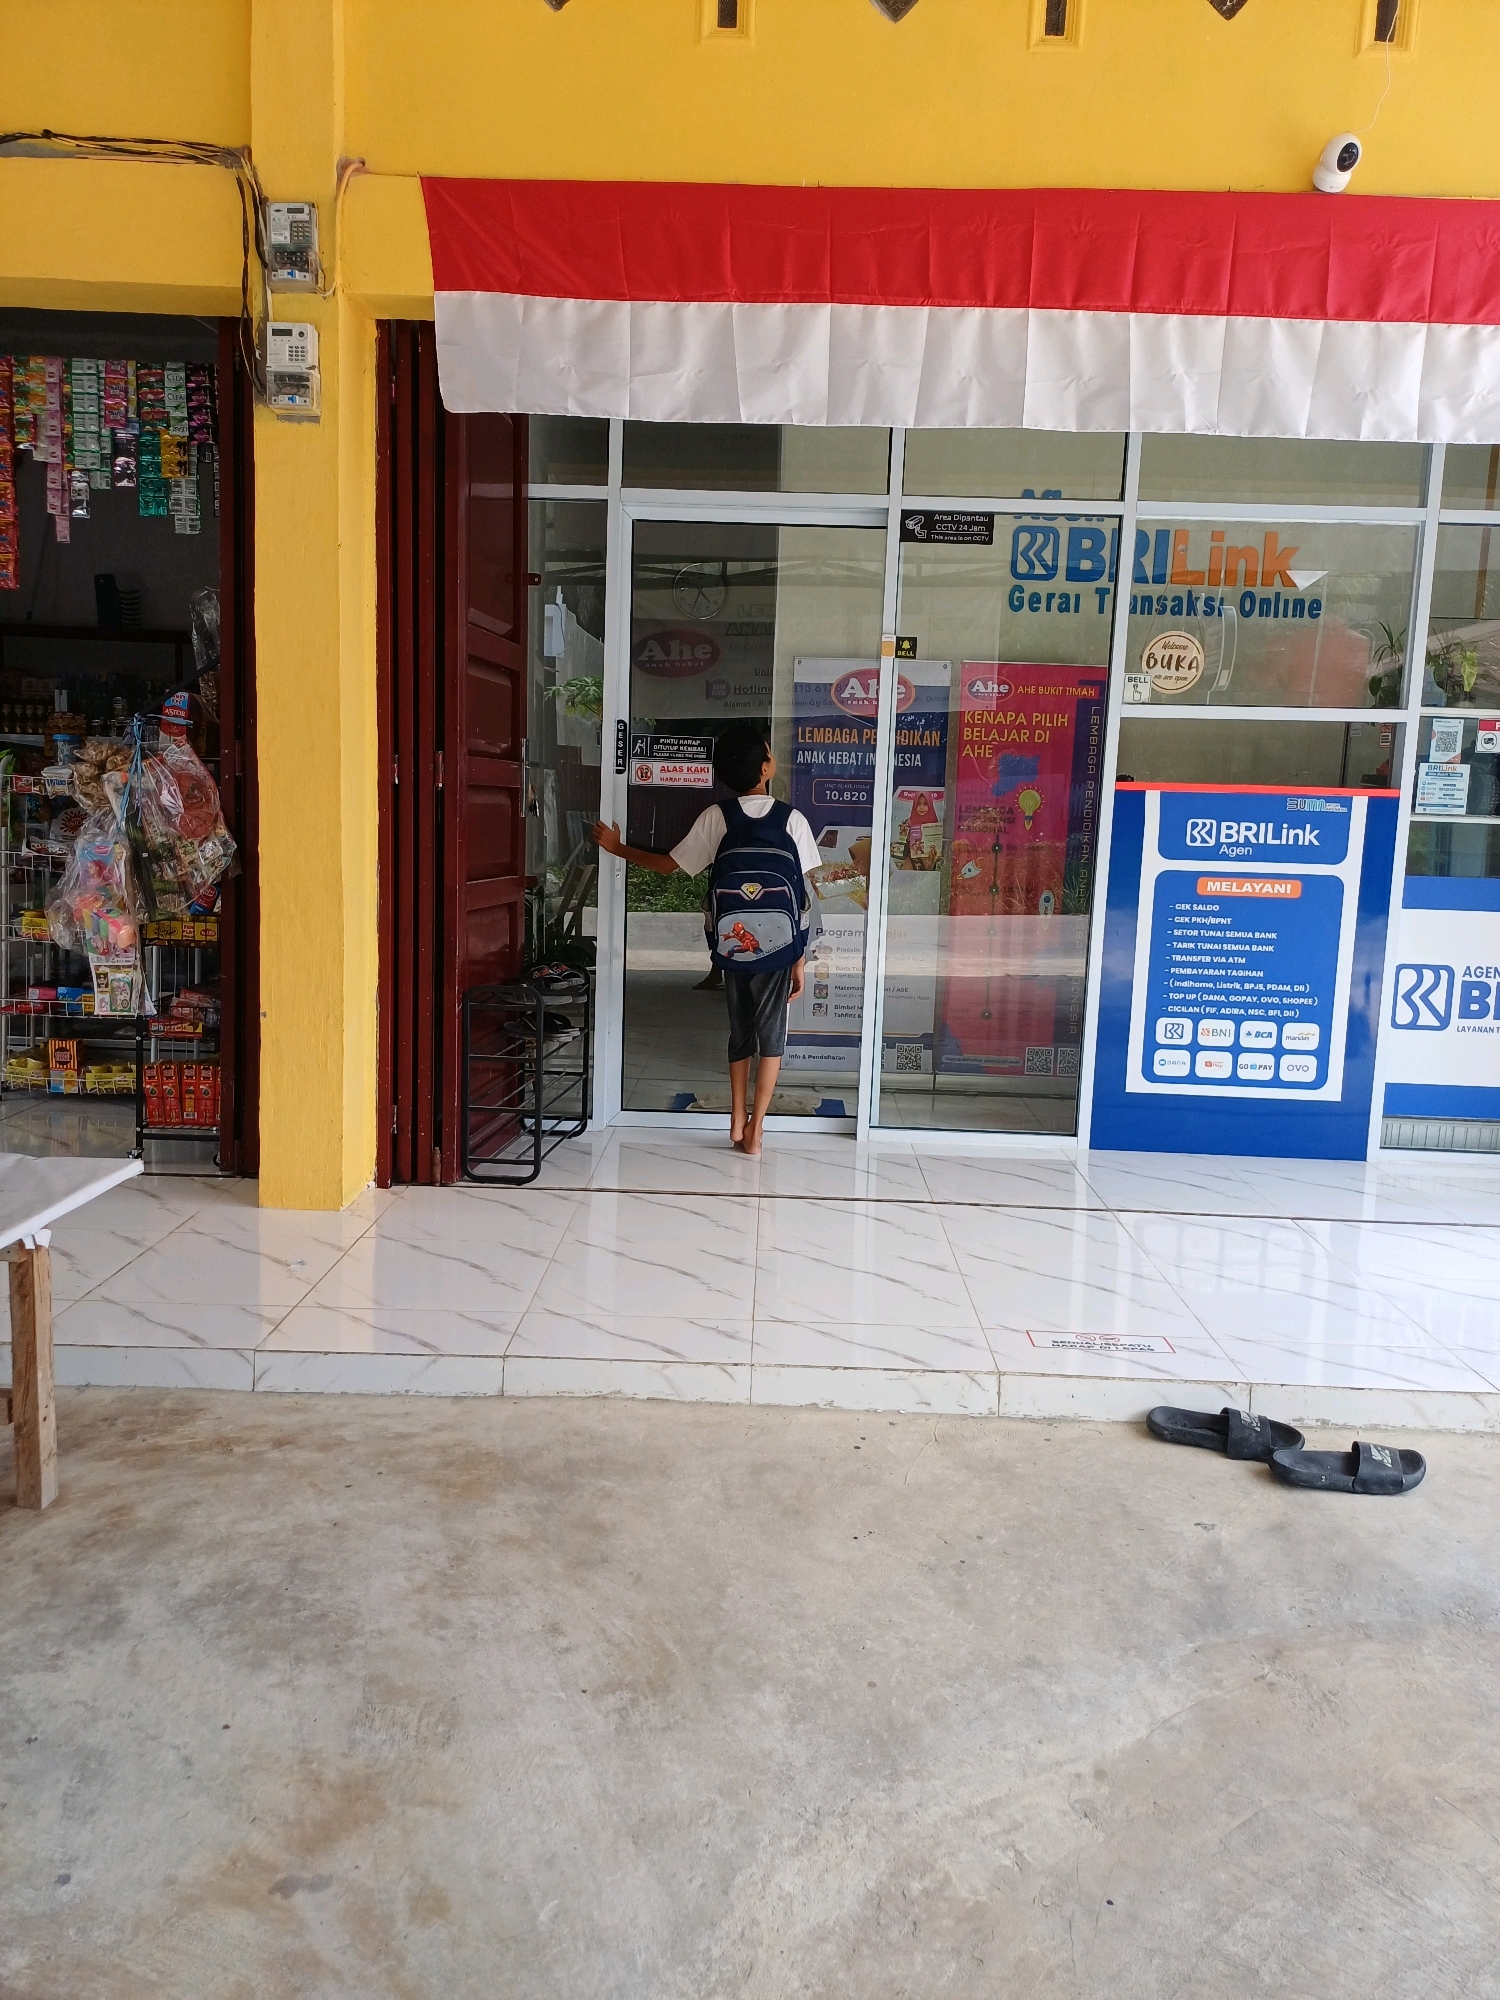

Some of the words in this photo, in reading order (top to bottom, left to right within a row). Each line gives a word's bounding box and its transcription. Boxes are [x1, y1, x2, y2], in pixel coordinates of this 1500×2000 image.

[167, 373, 184, 382] CLEA
[167, 392, 185, 401] CLEA
[953, 514, 989, 523] Dipantau
[936, 523, 958, 531] CCTV
[969, 524, 986, 532] Jam
[1066, 527, 1299, 587] BRILink
[1008, 585, 1081, 613] Gerai
[1095, 587, 1224, 618] Tansaksi
[1239, 590, 1322, 620] Online
[638, 639, 713, 662] Ahe
[1145, 652, 1200, 673] BUKA
[1127, 676, 1148, 684] BELL
[972, 680, 1009, 693] Ahe
[1017, 686, 1036, 694] AHE
[1038, 686, 1063, 696] BUKIT
[1065, 687, 1095, 697] TIMAH
[964, 710, 1027, 726] KENAPA
[1032, 713, 1068, 727] PILIH
[797, 726, 859, 744] LEMBAGA
[862, 728, 941, 747] PEIDIKAN
[963, 727, 1029, 743] BELAJAR
[1034, 729, 1050, 743] DI
[1086, 706, 1101, 774] LEMBAGA
[617, 723, 625, 766] GESER
[961, 744, 993, 759] AHE
[797, 750, 826, 765] ANAK
[828, 752, 863, 766] HEBAT
[659, 765, 684, 773] ALAS
[686, 766, 710, 774] KAKI
[825, 790, 867, 801] 10.820
[1219, 821, 1320, 846] BRILink
[1219, 844, 1253, 858] Agen
[1206, 880, 1292, 894] MELAYANI
[1191, 916, 1232, 925] PKH/BPNT
[1173, 929, 1199, 937] SETOR
[1171, 954, 1211, 962] TRANSFER
[1170, 967, 1226, 976] PEMBAYARAN
[1227, 969, 1264, 977] TAGIHAN
[1169, 992, 1185, 1000] TOP
[1458, 980, 1500, 1021] B
[1167, 1005, 1200, 1013] CICILAN
[1211, 1028, 1231, 1038] BNI
[1254, 1031, 1273, 1039] BCA
[1456, 1025, 1495, 1034] LAYANAN
[788, 1053, 801, 1061] Info
[808, 1053, 846, 1061] Pendaftaran
[1286, 1064, 1310, 1073] OVO
